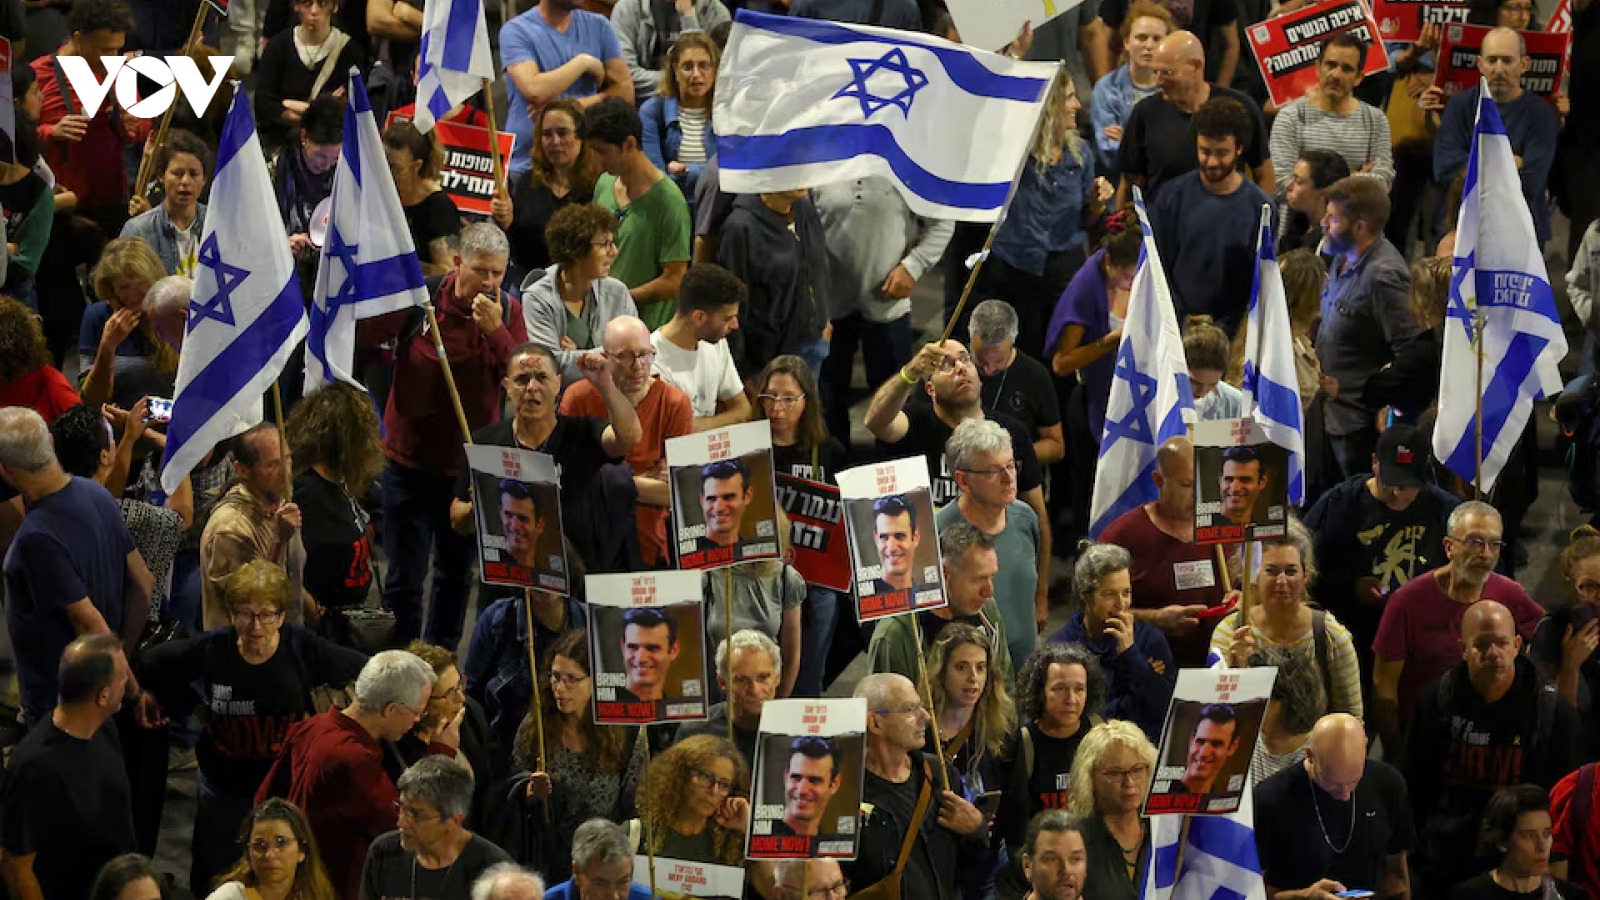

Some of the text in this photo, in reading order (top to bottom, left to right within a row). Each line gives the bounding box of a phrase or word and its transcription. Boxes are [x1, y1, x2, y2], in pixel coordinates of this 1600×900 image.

[1330, 5, 1364, 30] איפה
[1286, 16, 1330, 44] הנשים
[1196, 501, 1221, 516] BRING
[679, 524, 706, 541] BRING
[1196, 526, 1220, 541] HOME
[1221, 524, 1246, 539] NOW!
[680, 551, 705, 568] HOME
[707, 546, 733, 565] NOW!
[858, 565, 882, 582] BRING
[860, 595, 882, 612] HOME
[884, 589, 910, 608] NOW!
[596, 672, 626, 687] BRING
[596, 687, 616, 701] HIM
[597, 702, 625, 717] HOME
[627, 701, 657, 718] NOW!
[1156, 766, 1186, 781] BRING
[754, 804, 784, 820] BRING
[751, 836, 778, 852] HOME
[780, 835, 810, 852] NOW!
